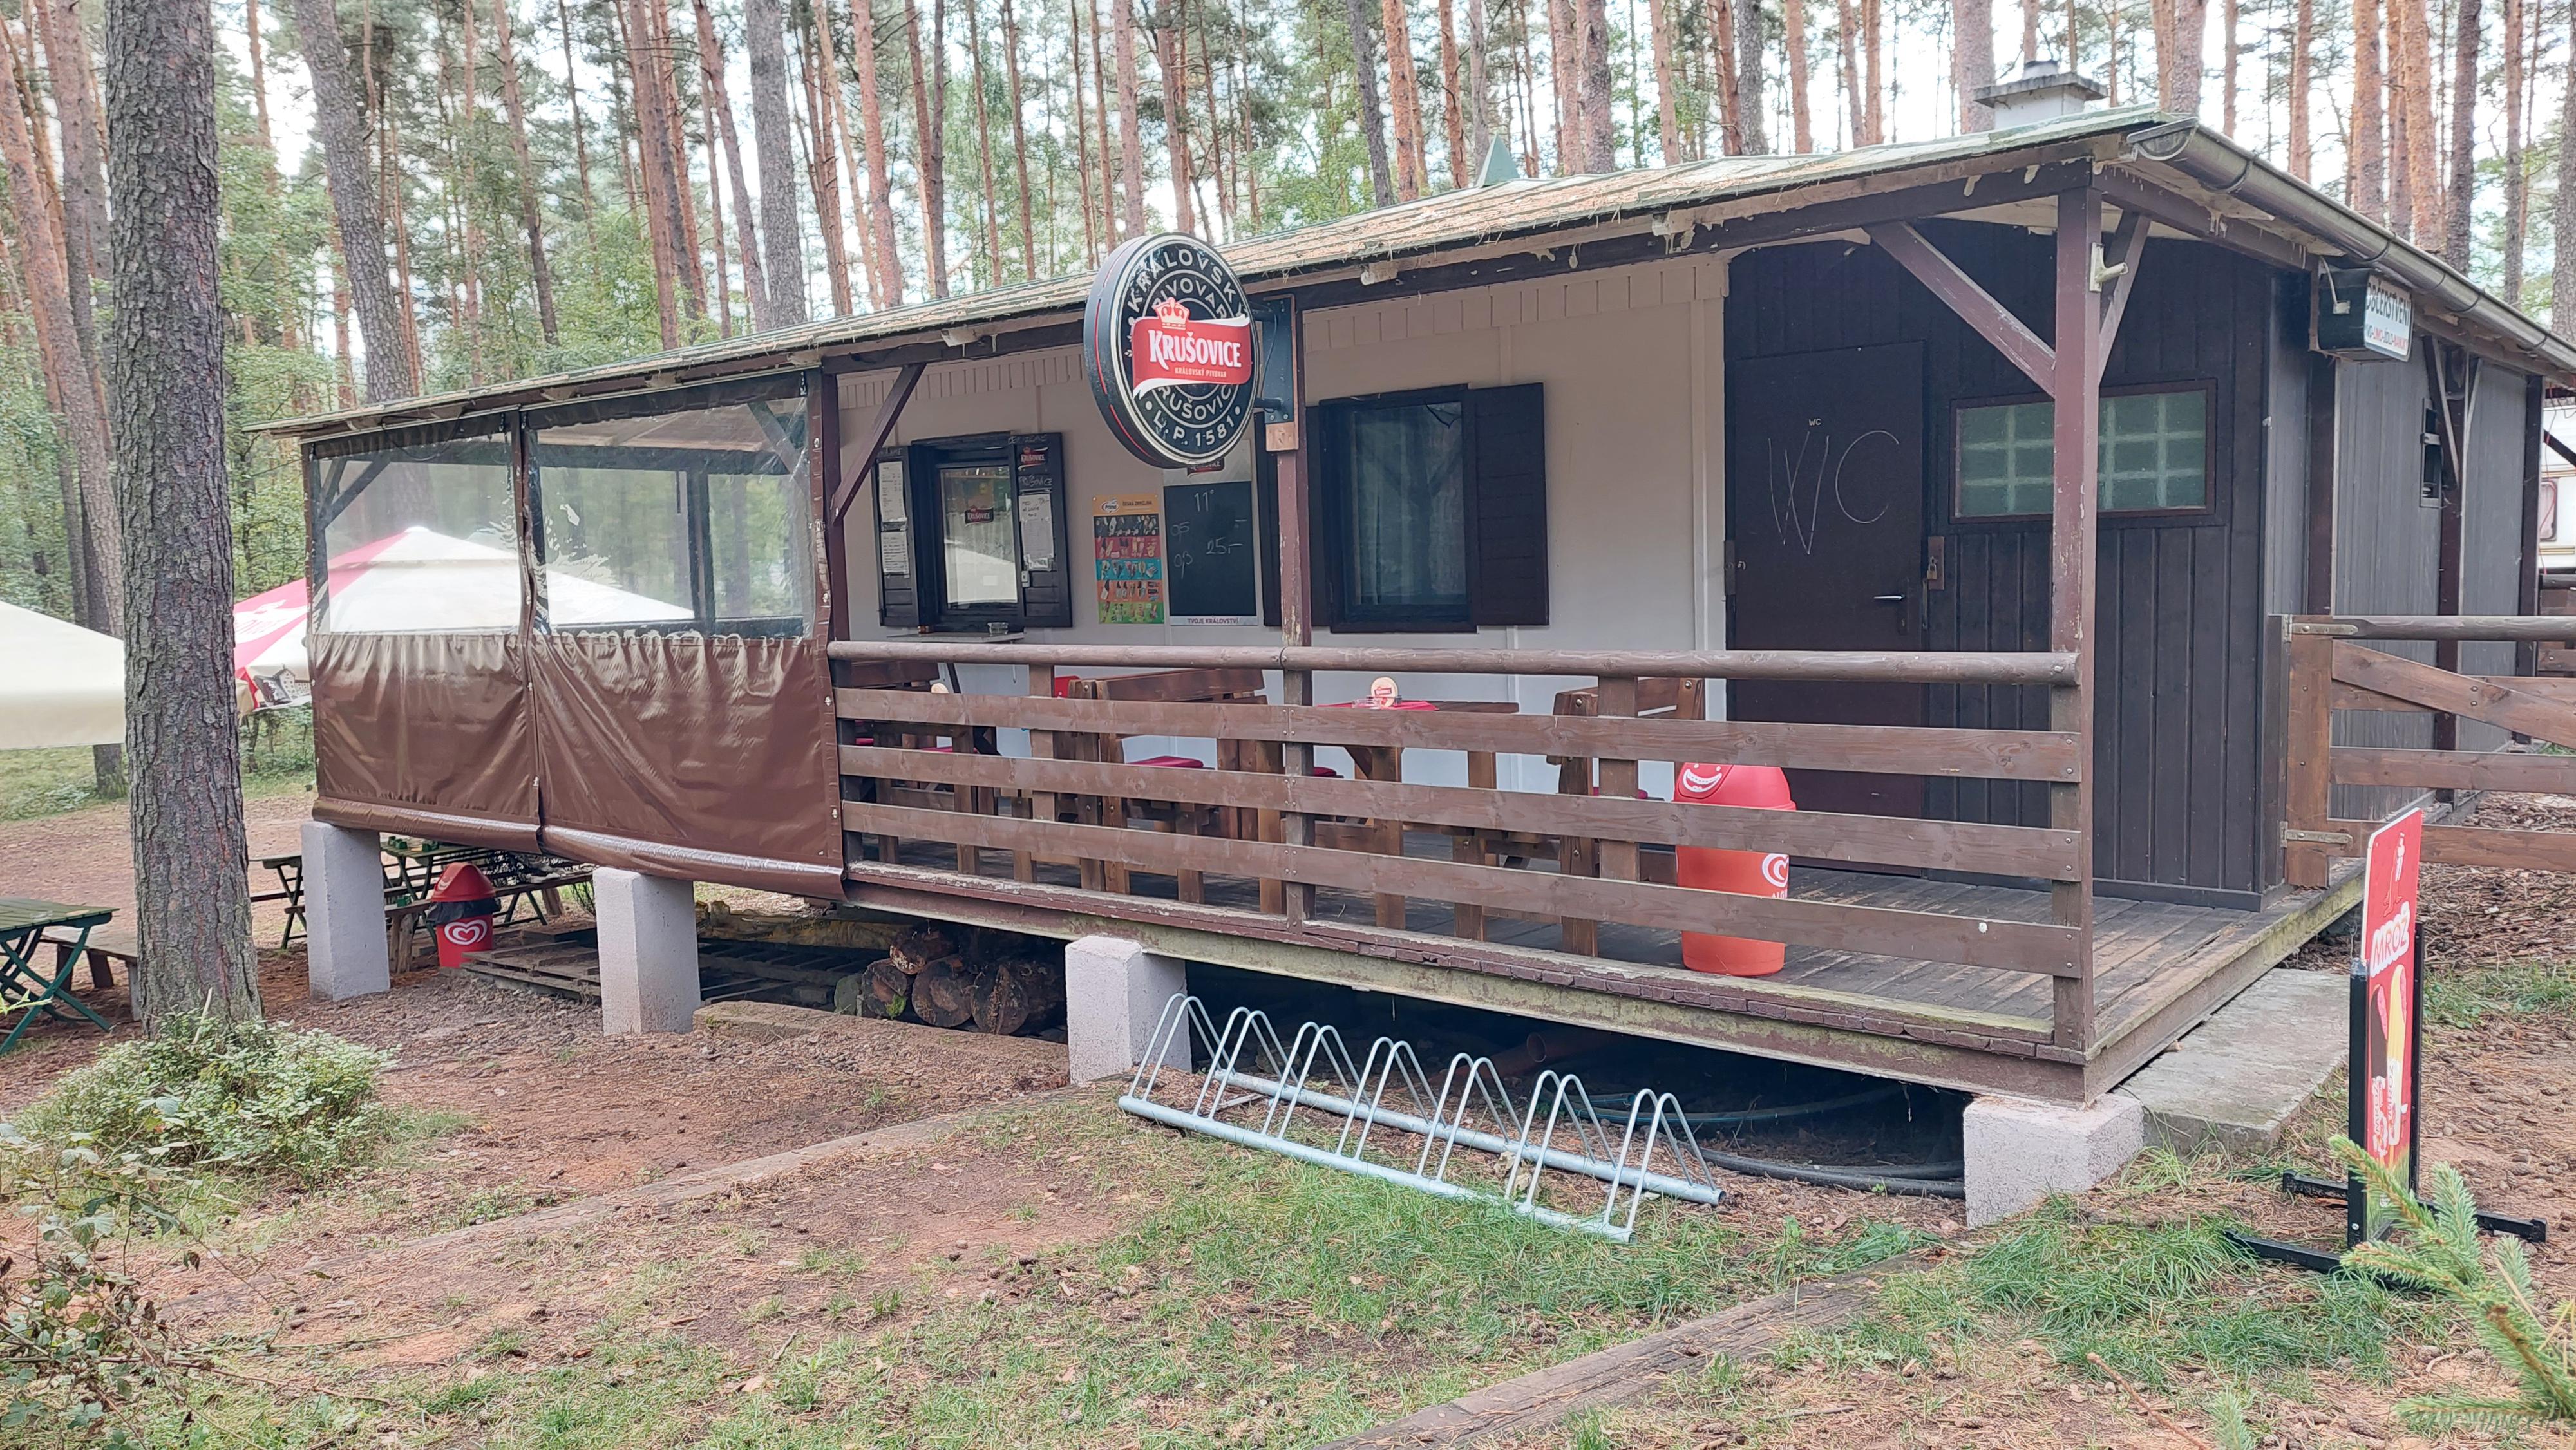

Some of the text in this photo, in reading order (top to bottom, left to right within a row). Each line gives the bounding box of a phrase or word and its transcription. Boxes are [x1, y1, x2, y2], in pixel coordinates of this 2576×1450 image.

[1151, 278, 1227, 319] PIVOVAR
[1148, 330, 1242, 370] KRUŠOVICE
[1158, 385, 1231, 420] RUŠOVIC
[1195, 415, 1235, 447] 1581
[1808, 418, 1821, 426] WC
[1767, 429, 1900, 555] WC
